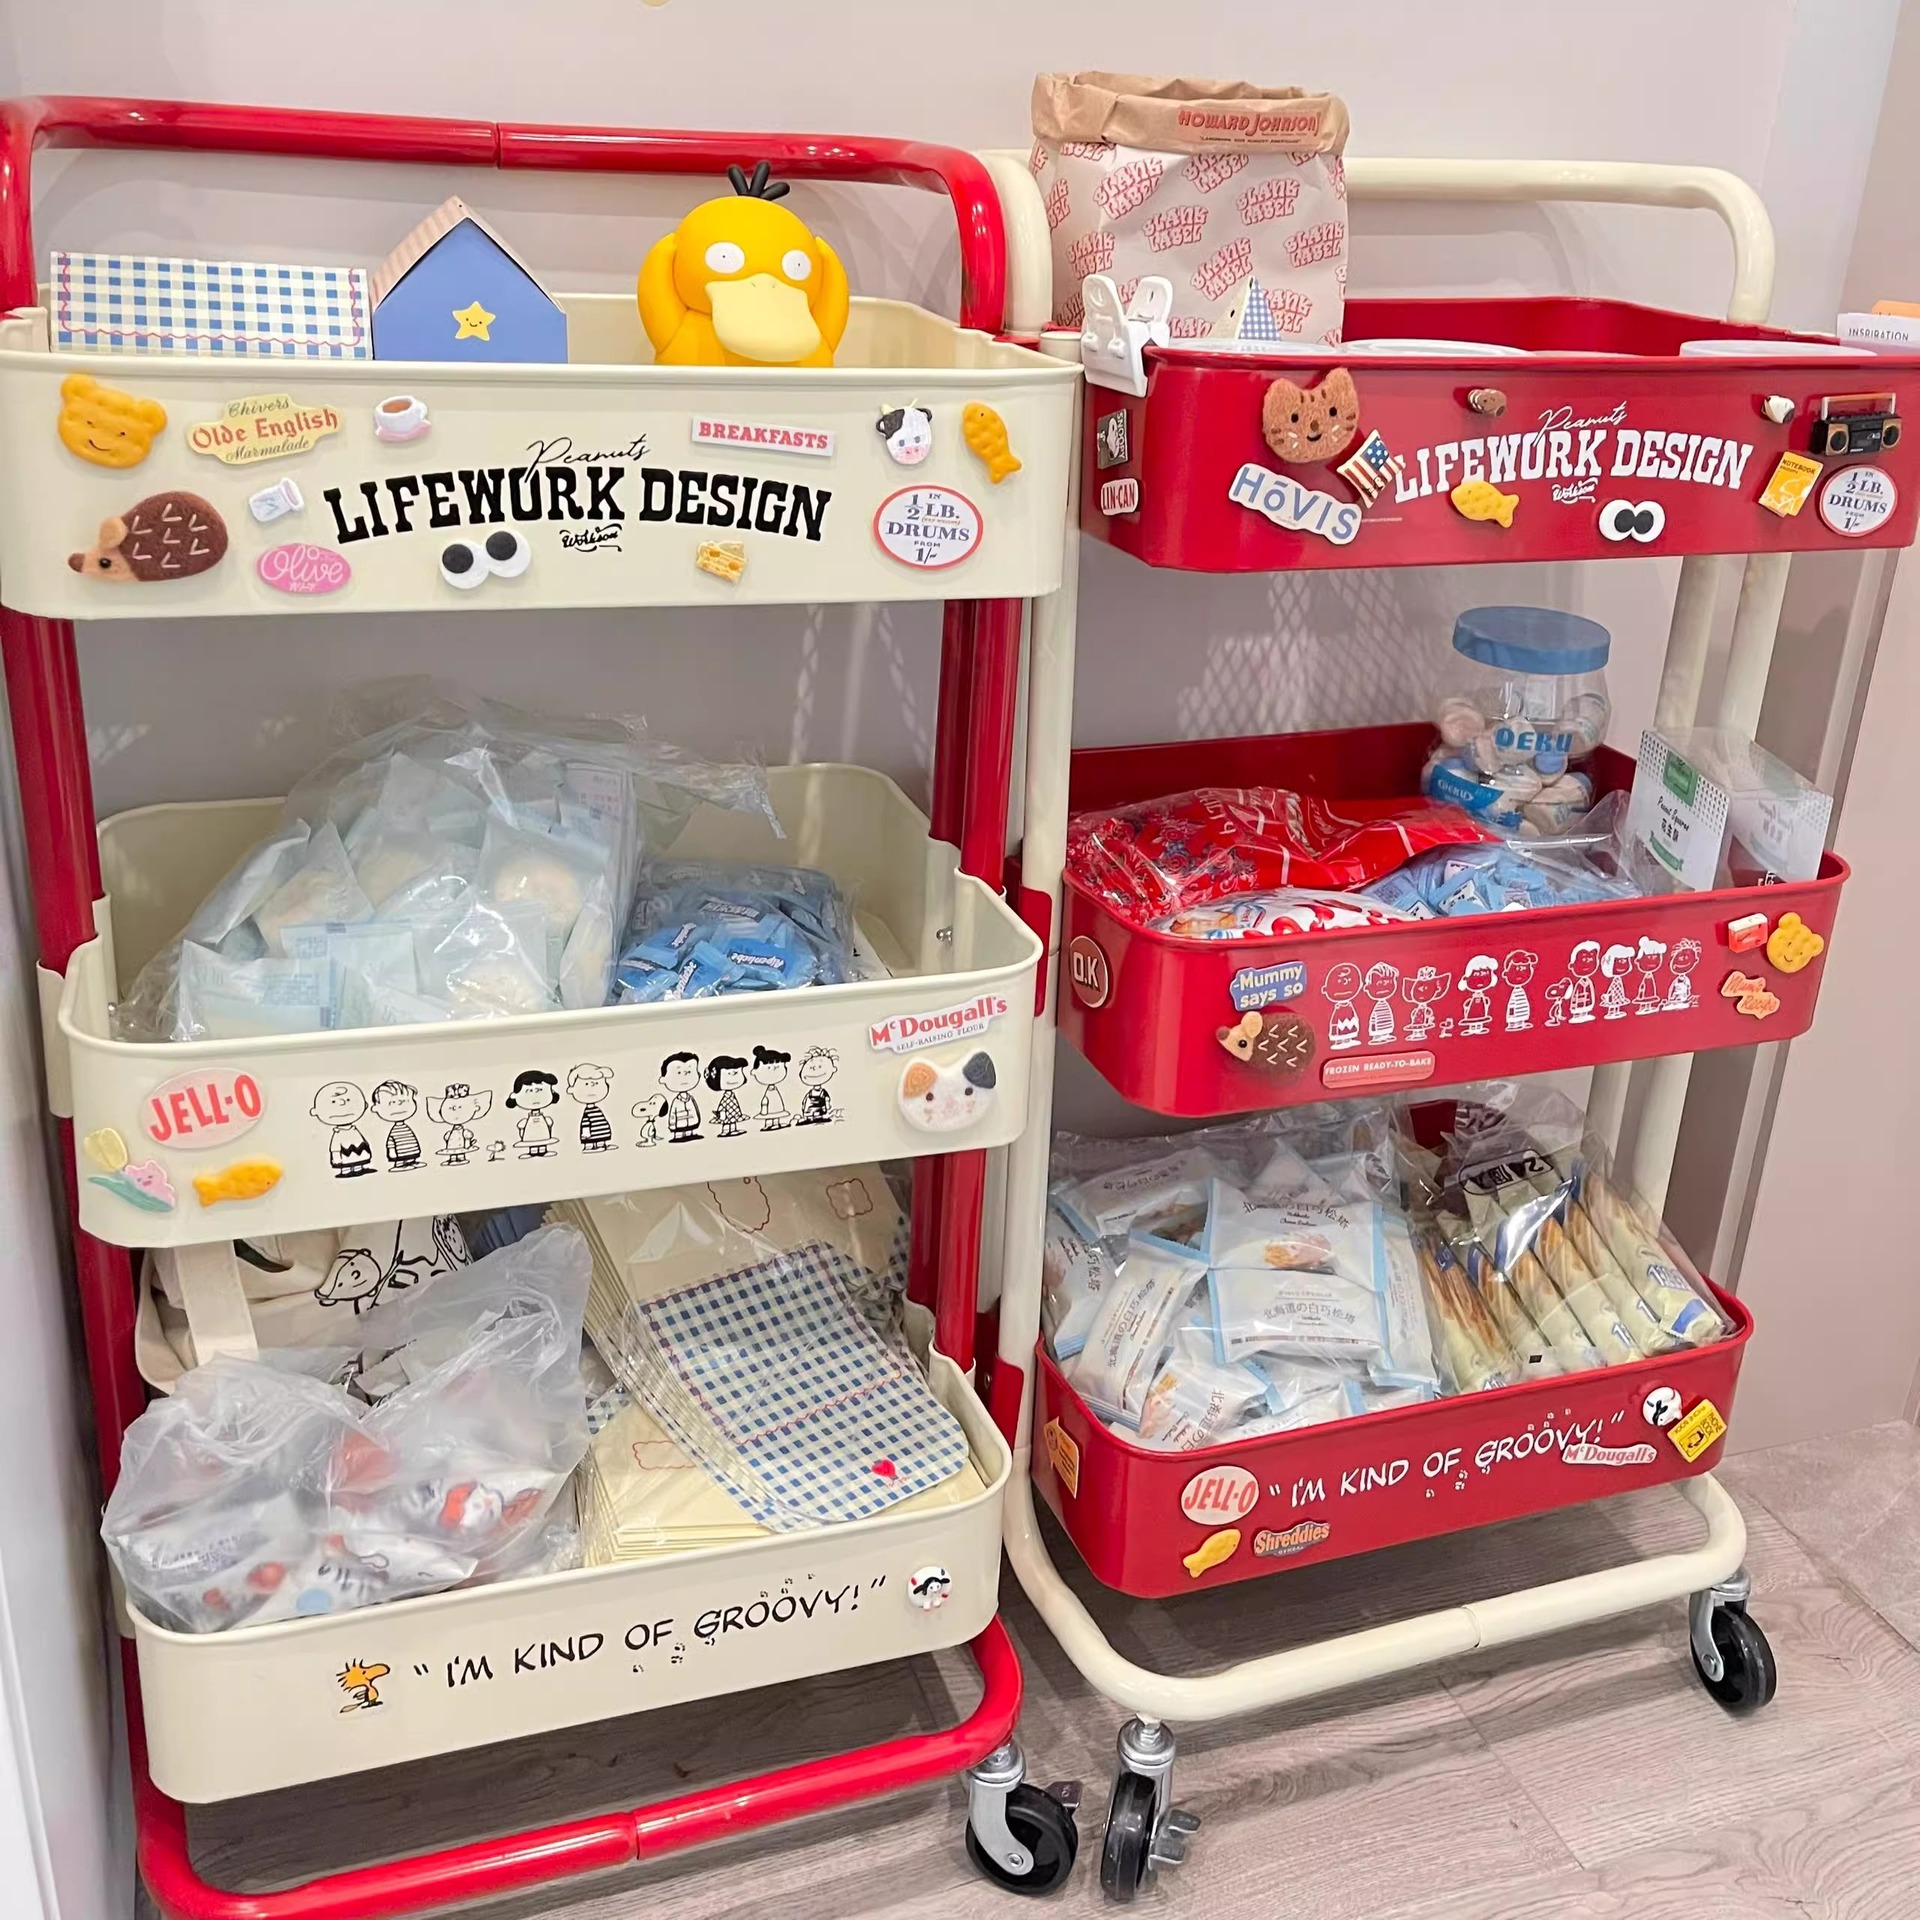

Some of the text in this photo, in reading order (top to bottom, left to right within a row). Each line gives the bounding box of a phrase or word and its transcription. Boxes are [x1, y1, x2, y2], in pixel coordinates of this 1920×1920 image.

[1178, 111, 1250, 130] HOWARD
[1093, 157, 1163, 206] BLANK
[1236, 180, 1300, 210] BLANK
[1142, 205, 1208, 237] BLANK
[1241, 199, 1295, 226] LABEL
[1066, 232, 1115, 263] BLANK
[1149, 224, 1202, 252] LABEL
[1283, 220, 1344, 253] BLANK
[1190, 237, 1251, 290] BLANK
[1290, 240, 1341, 268] LABEL
[1202, 256, 1253, 301] LABEL
[228, 398, 290, 418] Chivers
[193, 408, 338, 449] Olde English
[699, 421, 828, 450] BREAKFASTS
[1117, 412, 1125, 459] SNOOPY
[1536, 401, 1627, 447] Peanuts
[226, 435, 310, 461] Marmalade
[526, 434, 651, 483] Peanuts
[1395, 429, 1753, 504] LIFEWORK DESIGN
[323, 466, 832, 544] LIFEWORK DESIGN
[926, 503, 960, 519] LB.
[1829, 494, 1887, 514] DRUMS
[885, 521, 970, 541] DRUMS
[261, 545, 344, 583] Olive
[1240, 981, 1303, 1008] says so
[870, 995, 1008, 1046] McDougall's
[897, 1023, 985, 1051] SELF-RAISING FLOUR
[1325, 1064, 1359, 1075] FROZEN
[1564, 1444, 1656, 1464] McDougall's
[1340, 1459, 1410, 1497] KIND
[1422, 1448, 1462, 1478] OF
[1255, 1524, 1330, 1553] Shreddies
[513, 1632, 604, 1671] KIND
[625, 1619, 673, 1651] OF
